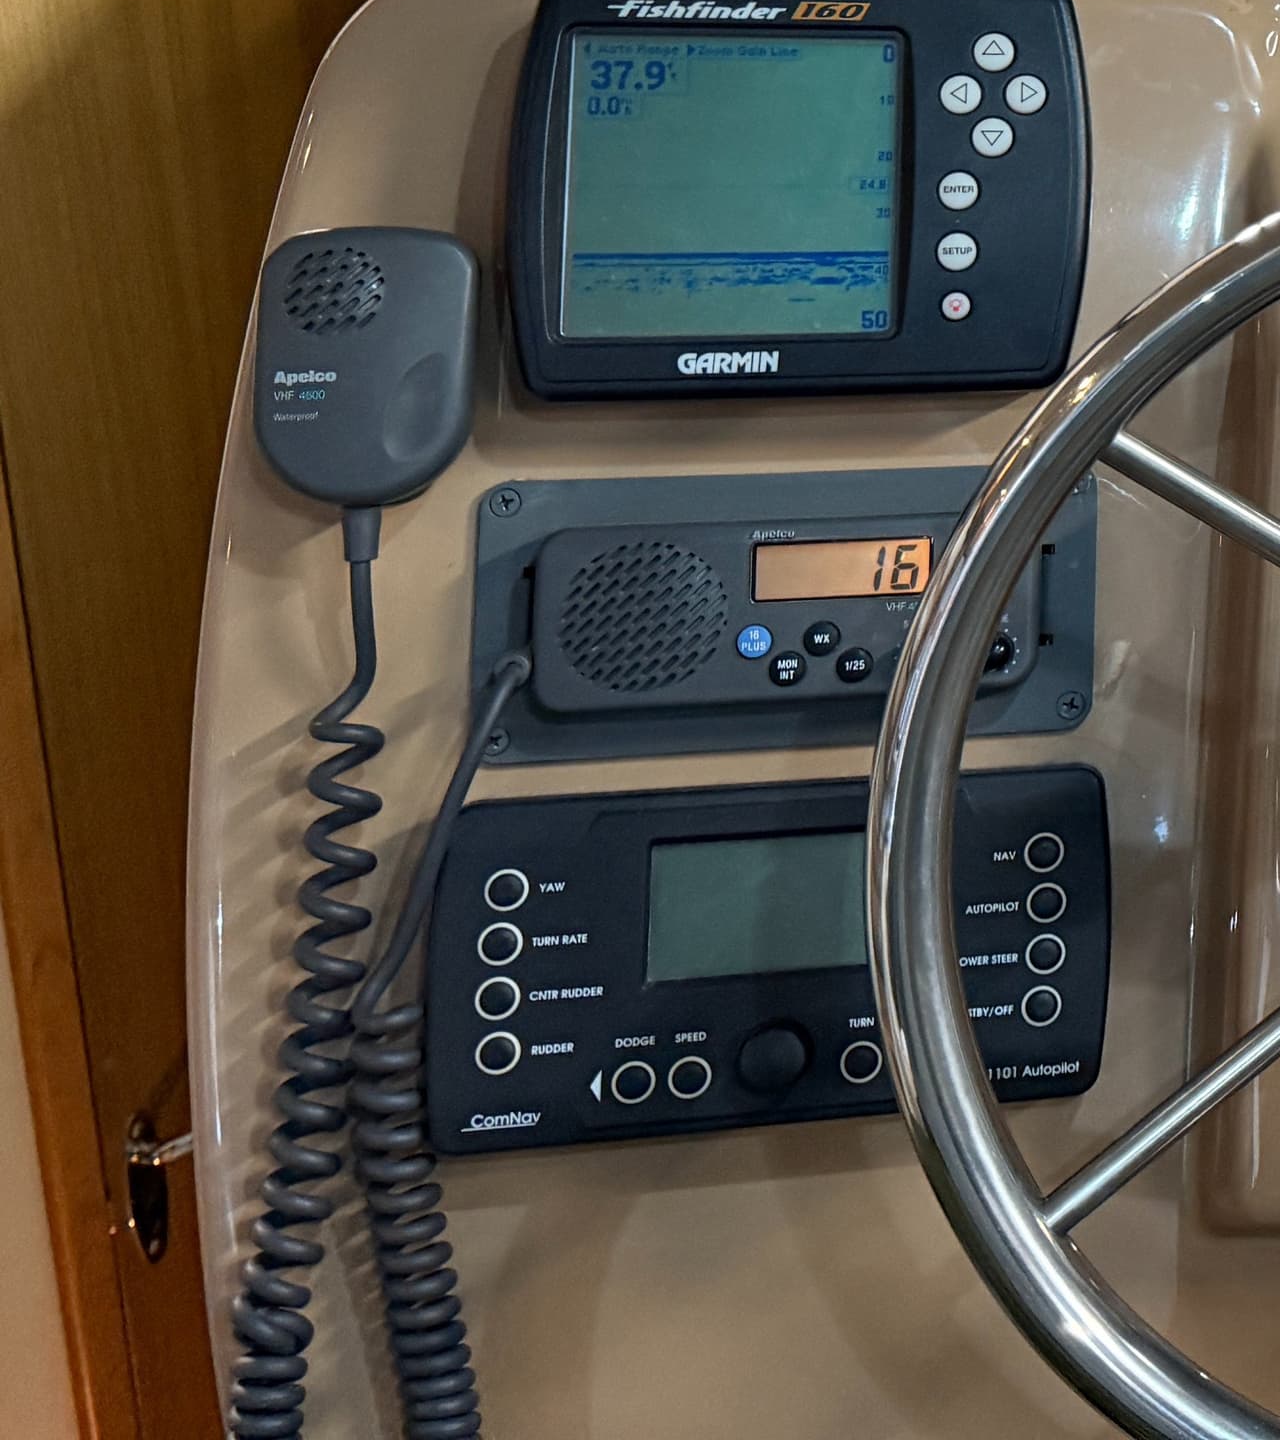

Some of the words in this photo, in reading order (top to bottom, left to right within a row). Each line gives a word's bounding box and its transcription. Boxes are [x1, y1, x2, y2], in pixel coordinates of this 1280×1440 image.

[607, 0, 787, 21] Fishfinder
[799, 3, 864, 19] 160
[882, 44, 896, 63] 0
[590, 60, 666, 91] 37.9
[587, 95, 620, 116] 0.0
[880, 95, 895, 106] 10
[878, 151, 893, 162] 20
[943, 185, 975, 194] ENTER
[942, 246, 973, 256] SETUP
[861, 311, 888, 330] 50
[677, 350, 779, 375] GARMIN
[274, 370, 337, 387] Apelco
[274, 390, 295, 401] VHF
[752, 528, 796, 541] Apelco
[873, 544, 919, 592] 16
[886, 601, 907, 612] VHF
[749, 630, 760, 640] 16
[814, 633, 830, 645] WX
[741, 640, 767, 652] PLUS
[777, 659, 798, 670] MON
[845, 660, 866, 672] 1/25
[779, 670, 796, 681] INT
[994, 851, 1017, 862] NAV
[539, 882, 566, 894] YAW
[965, 901, 1020, 915] AUTOPILOT
[532, 935, 560, 947] TURN
[562, 933, 588, 946] RATE
[992, 953, 1019, 965] STEER
[529, 989, 559, 1002] CNTR
[561, 986, 604, 1000] RUDDER
[849, 1016, 875, 1029] TURN
[615, 1035, 656, 1049] DODGE
[675, 1031, 708, 1044] SPEED
[531, 1042, 575, 1056] RUDDER
[1022, 1061, 1080, 1079] Autopilot
[470, 1111, 542, 1129] ComNav
